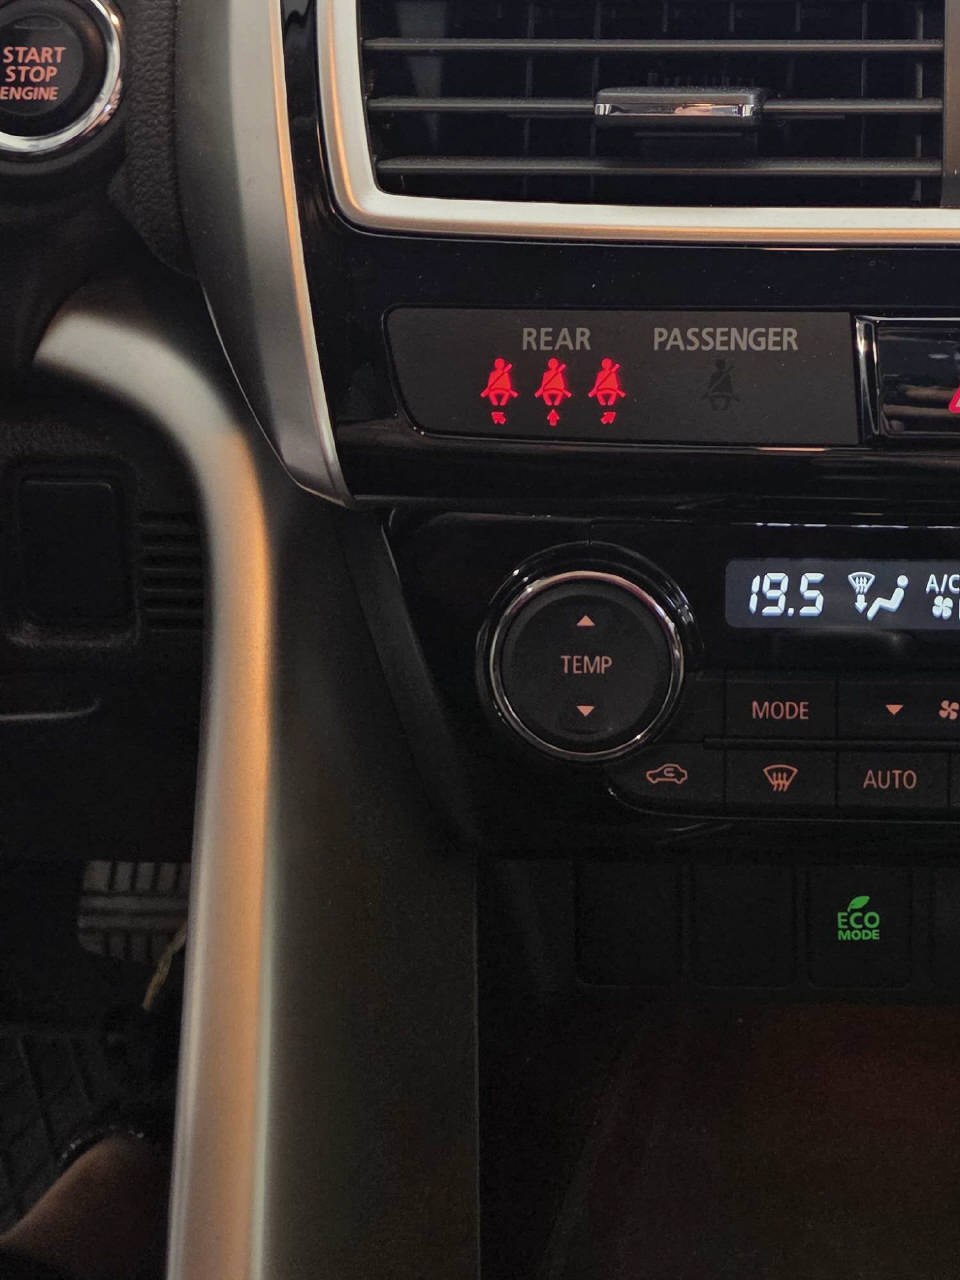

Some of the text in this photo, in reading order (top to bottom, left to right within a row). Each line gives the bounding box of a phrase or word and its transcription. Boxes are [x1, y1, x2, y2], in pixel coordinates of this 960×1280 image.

[3, 46, 66, 64] START
[5, 66, 58, 83] STOP
[0, 86, 59, 101] ENGINE
[521, 327, 592, 351] REAR
[653, 327, 799, 352] PASSENGER
[925, 574, 960, 595] A/C
[748, 573, 825, 617] 19.5
[560, 655, 613, 675] TEMP
[751, 701, 809, 720] MODE
[863, 770, 917, 790] AUTO
[837, 911, 880, 929] ECO
[837, 929, 880, 941] MODE
